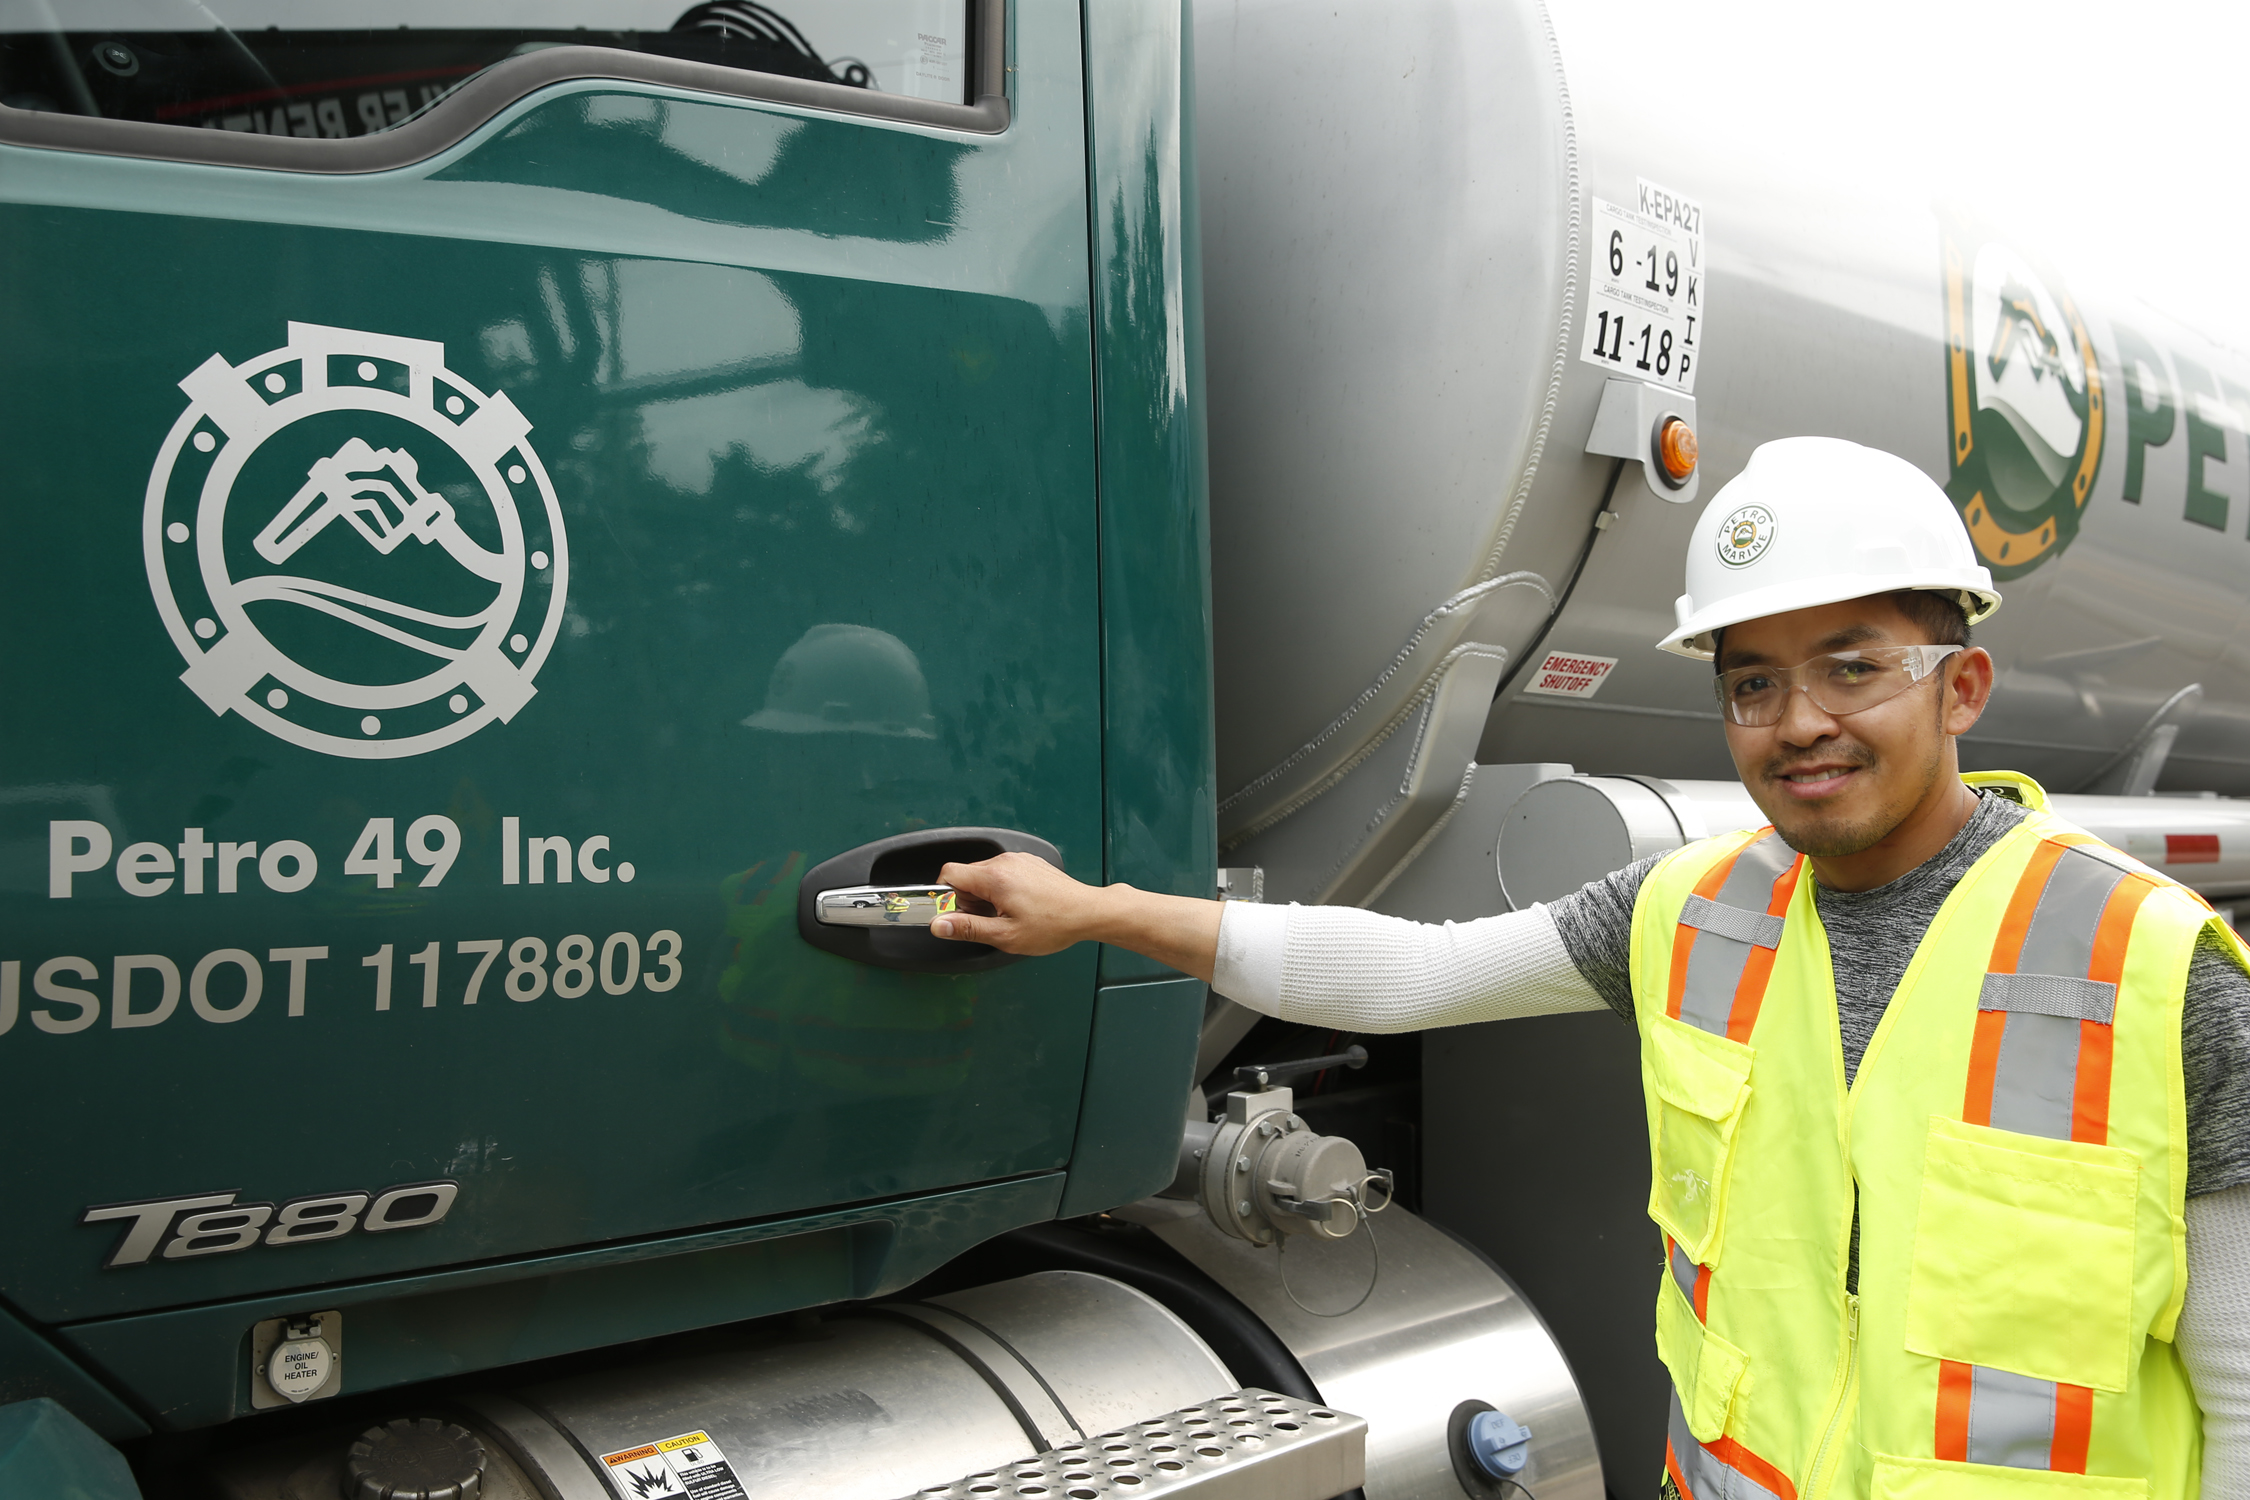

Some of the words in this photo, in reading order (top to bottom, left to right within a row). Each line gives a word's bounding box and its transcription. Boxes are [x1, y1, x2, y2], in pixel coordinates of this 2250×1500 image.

[917, 33, 946, 45] PACCAR
[1638, 182, 1700, 235] K-EPA27
[1604, 284, 1620, 297] CARGO
[2109, 318, 2250, 542] PE
[1724, 509, 1767, 534] PETRO
[1722, 534, 1768, 560] MARINE
[1542, 656, 1613, 678] EMERGENCY
[1539, 673, 1594, 692] SHUTOFF
[48, 818, 318, 899] Petro
[344, 814, 462, 890] 49
[502, 815, 636, 886] Inc.
[361, 928, 684, 1012] 1178803
[80, 1178, 460, 1269] T880
[285, 1351, 319, 1362] ENGINE/
[294, 1362, 308, 1370] OIL
[284, 1369, 317, 1380] HEATER
[664, 1436, 701, 1449] CAUTION
[616, 1447, 654, 1462] WARNING
